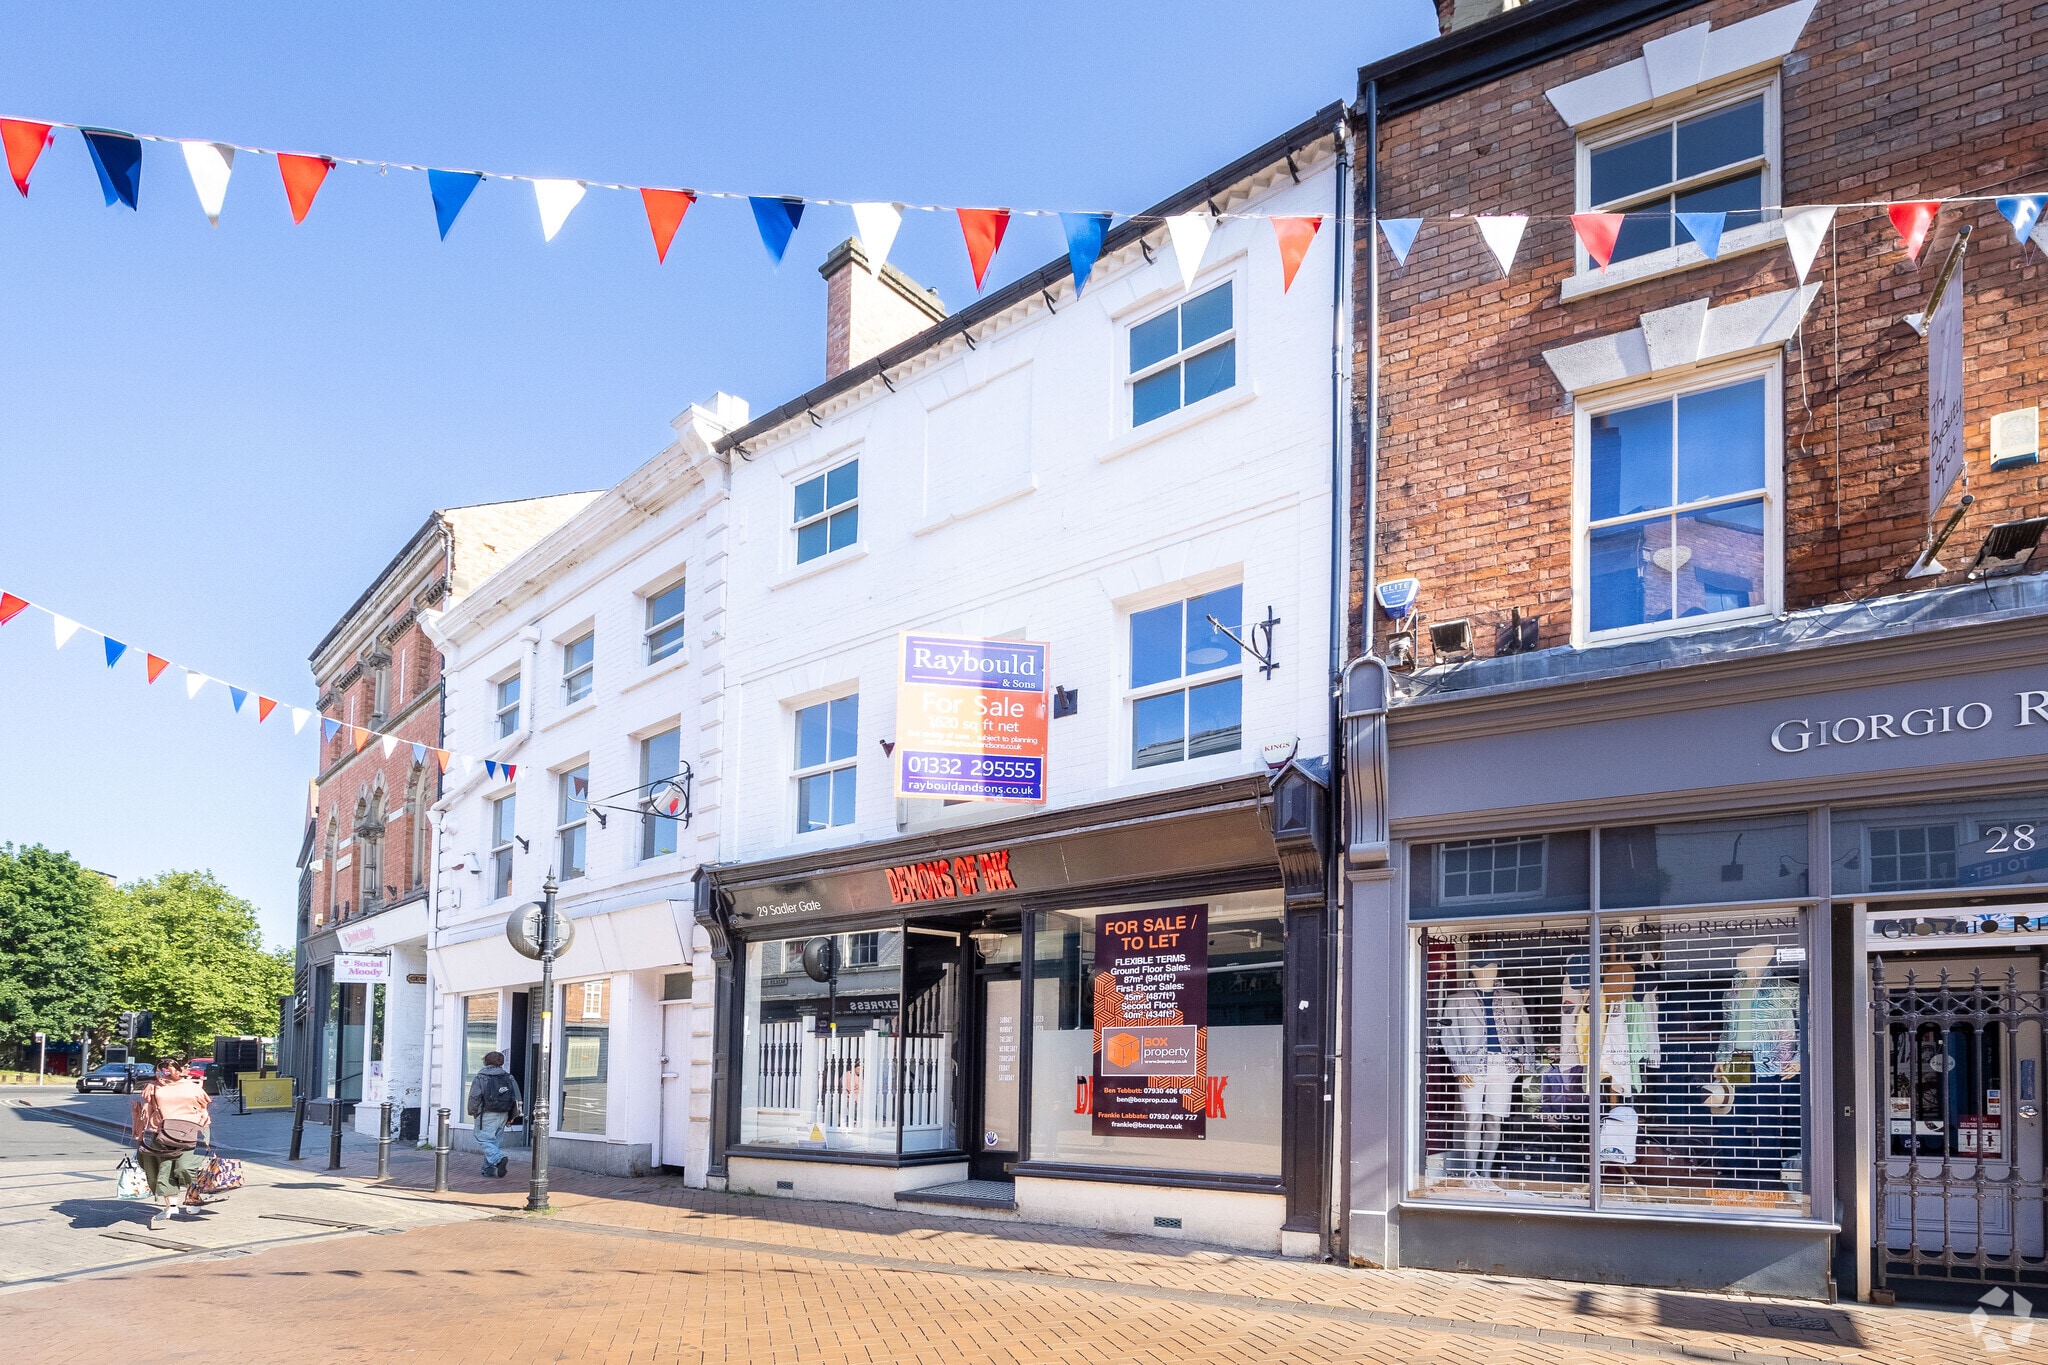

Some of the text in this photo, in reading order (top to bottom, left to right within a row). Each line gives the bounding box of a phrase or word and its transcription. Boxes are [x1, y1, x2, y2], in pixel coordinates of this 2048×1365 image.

[1382, 582, 1410, 593] ELITE
[913, 647, 1036, 676] Raybould
[1002, 678, 1036, 689] & Sons
[922, 689, 1025, 718] For Sale
[963, 720, 978, 733] sq
[983, 718, 994, 731] ft
[998, 721, 1019, 733] net
[1770, 702, 1993, 753] GIORGIO
[977, 734, 1001, 743] subject
[1011, 737, 1038, 745] planning
[1264, 741, 1291, 752] KINGS
[908, 756, 1035, 779] 01332 295555
[908, 781, 1033, 796] raybouldandsons.co.uk
[1984, 824, 2036, 854] 28
[885, 849, 1017, 904] DEMONS OF INK
[756, 899, 821, 917] 29 Sadler Gate
[1105, 914, 1198, 936] FOR SALE /
[1121, 933, 1180, 951] TO LET
[354, 959, 383, 968] Social
[1115, 954, 1186, 966] FLEXIBLE TERMS
[348, 967, 382, 977] Moody
[1111, 963, 1191, 976] Ground Floor Sales:
[1124, 973, 1176, 984] 87m² (940ft²)
[1116, 982, 1185, 993] First Floor Sales:
[1146, 992, 1176, 1002] (487ft²)
[1121, 1000, 1178, 1011] Second Floor:
[1146, 1009, 1176, 1019] (434ft²)
[1144, 1037, 1168, 1047] BOX
[1143, 1047, 1190, 1058] property
[1116, 1096, 1178, 1104] ben@boxprop.co.uk
[1097, 1111, 1120, 1119] Frankie
[1121, 1112, 1148, 1120] Labbate:
[1111, 1120, 1183, 1130] frankie@boxprop.co.uk
